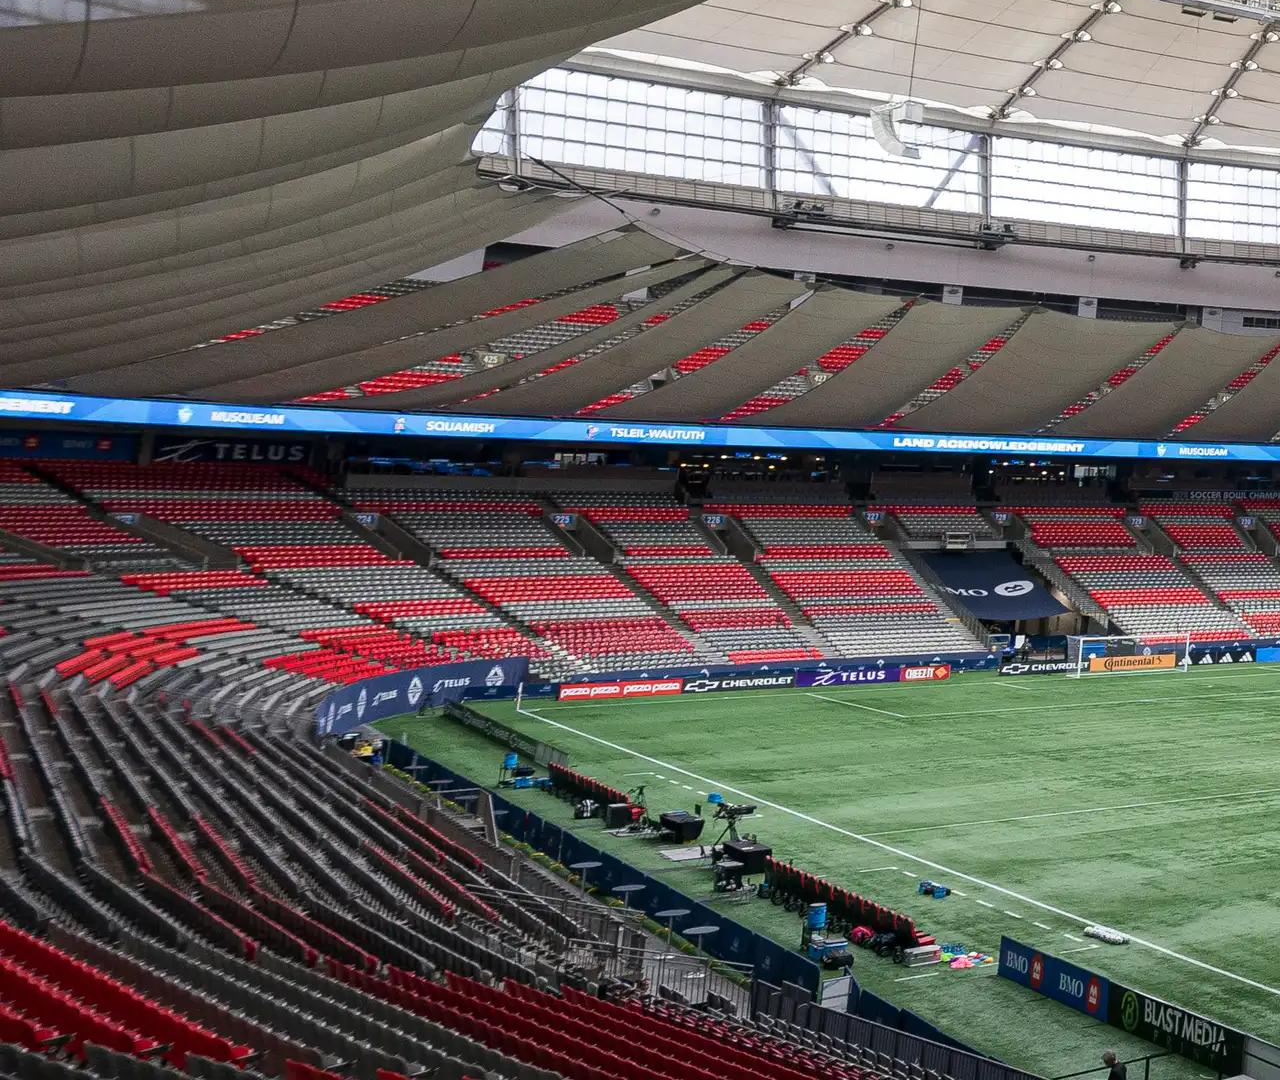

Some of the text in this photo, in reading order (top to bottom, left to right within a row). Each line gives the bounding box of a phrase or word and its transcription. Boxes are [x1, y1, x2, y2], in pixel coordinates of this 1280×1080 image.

[211, 411, 285, 425] MUSQUEAM
[426, 421, 495, 433] SQUAMISH
[610, 427, 704, 440] TSLEIL-WAUTUTH
[213, 443, 305, 461] TELUS
[893, 437, 1085, 454] LAND ACKNOWLEDGEMENT
[1179, 448, 1228, 457] MUSQUEAM
[1190, 491, 1221, 499] SOCCER
[1223, 491, 1247, 499] BOWL
[554, 515, 570, 524] 225
[706, 516, 720, 524] 226
[866, 512, 879, 521] 227
[1031, 661, 1090, 672] CHEVROLET
[1104, 656, 1155, 670] Continental
[442, 677, 470, 688] TELUS
[722, 676, 794, 689] CHEVROLET
[840, 670, 887, 682] TELUS
[560, 682, 681, 699] pizza pizza pizza pizza
[1006, 951, 1028, 975] BMO
[1059, 973, 1084, 998] BMO
[1144, 999, 1227, 1056] BLAST MEDIA
